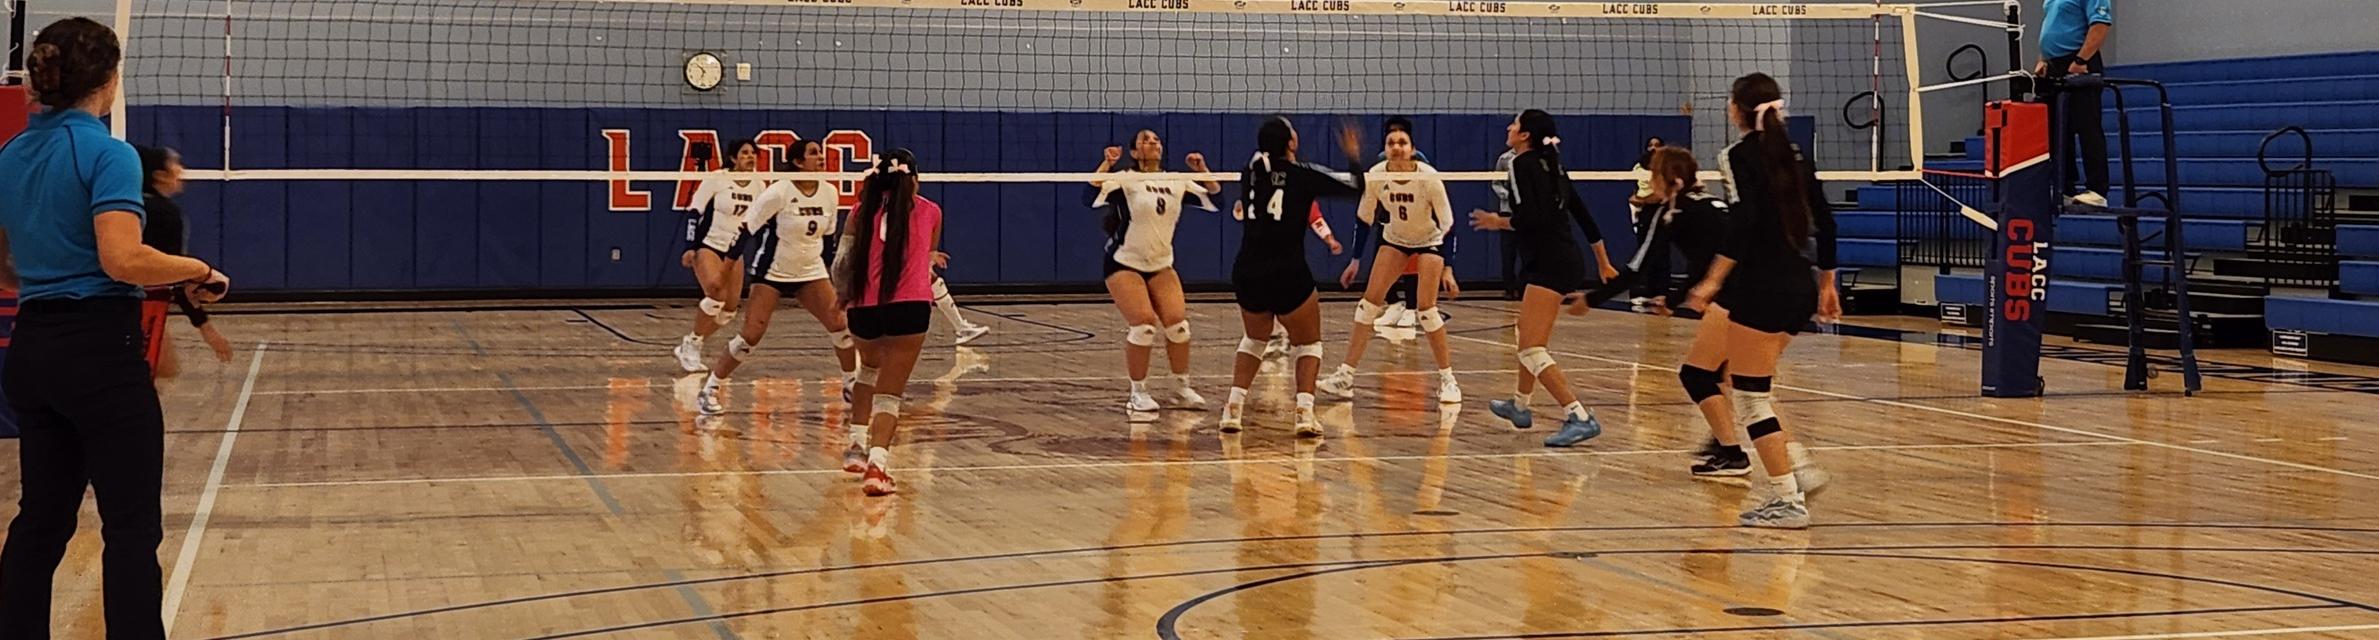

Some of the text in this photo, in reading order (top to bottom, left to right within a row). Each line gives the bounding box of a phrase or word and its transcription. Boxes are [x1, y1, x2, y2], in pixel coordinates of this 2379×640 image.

[1128, 0, 1188, 9] LACC CUBS
[1291, 0, 1350, 11] LACC CUBS
[1449, 1, 1506, 13] LACC CUBS
[1603, 4, 1658, 14] LACC CUBS
[1752, 5, 1806, 15] LACC CUBS
[732, 204, 749, 217] 17
[1398, 205, 1408, 221] 6
[805, 220, 818, 236] 9
[2004, 218, 2034, 321] CUBS
[2031, 241, 2049, 302] LACC
